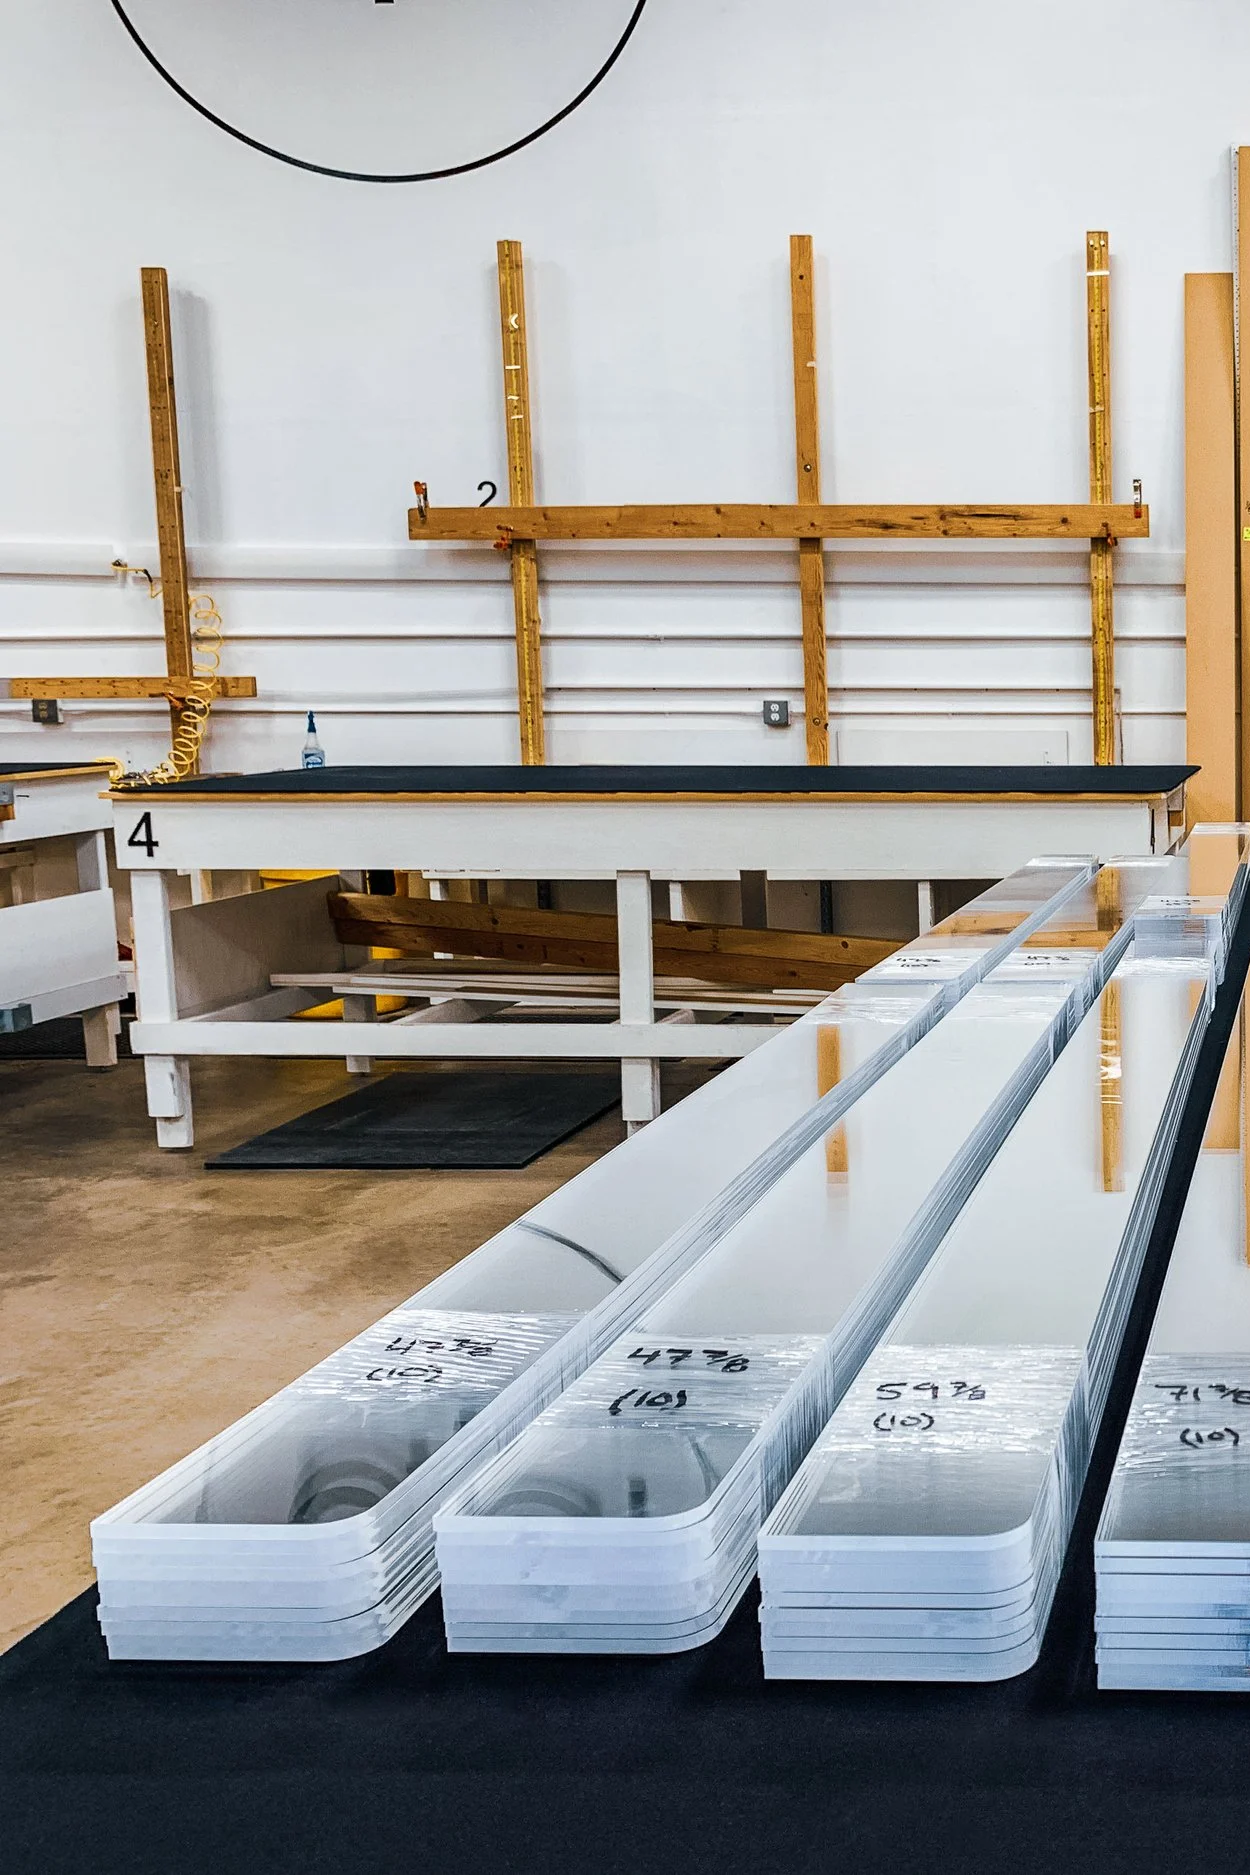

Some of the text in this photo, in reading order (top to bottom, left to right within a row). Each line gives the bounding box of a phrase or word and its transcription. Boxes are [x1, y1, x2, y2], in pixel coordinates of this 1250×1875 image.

[477, 481, 497, 507] 2
[128, 812, 159, 857] 4
[608, 1388, 687, 1416] (10)
[873, 1412, 935, 1432] (10)
[1179, 1427, 1240, 1449] (10)
